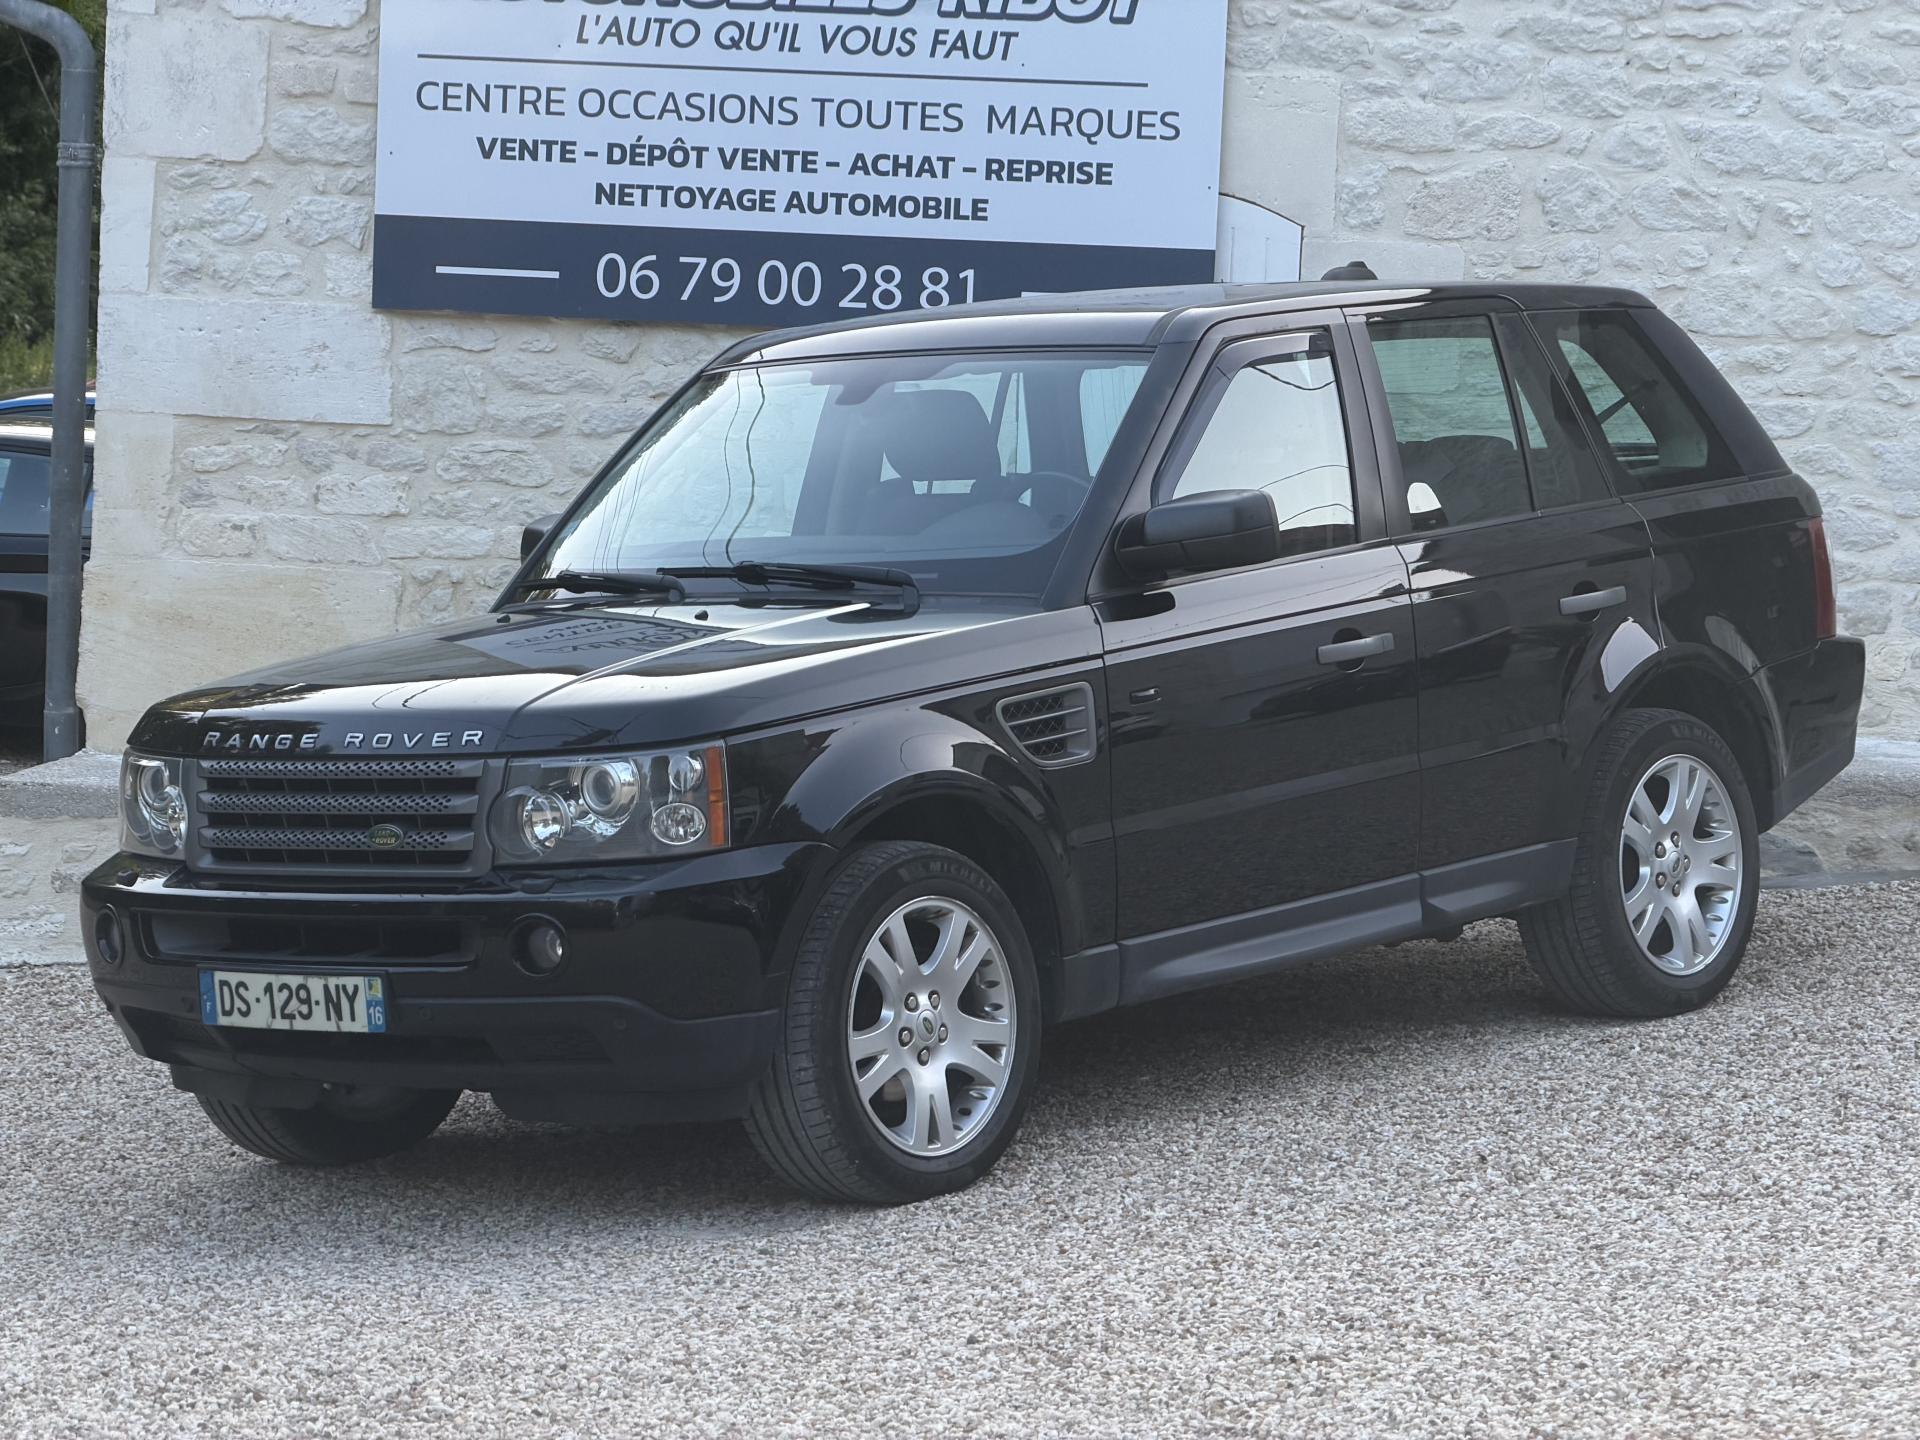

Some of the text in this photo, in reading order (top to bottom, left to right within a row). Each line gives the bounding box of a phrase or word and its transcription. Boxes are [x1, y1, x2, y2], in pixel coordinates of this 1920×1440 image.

[576, 14, 1020, 61] L'AUTO QU'IL VOUS FAUT
[416, 80, 1181, 146] CENTRE OCCASIONS TOUTES MARQUES
[475, 136, 577, 164] VENTE
[606, 135, 710, 169] DÉPÔT
[716, 146, 819, 174] VENTE
[847, 152, 956, 180] ACHAT
[984, 157, 1114, 186] REPRISE
[594, 182, 989, 222] NETTOYAGE AUTOMOBILE
[596, 252, 976, 311] 06 79 00 28 81
[202, 730, 484, 750] RANGE ROVER
[368, 1006, 384, 1026] 16
